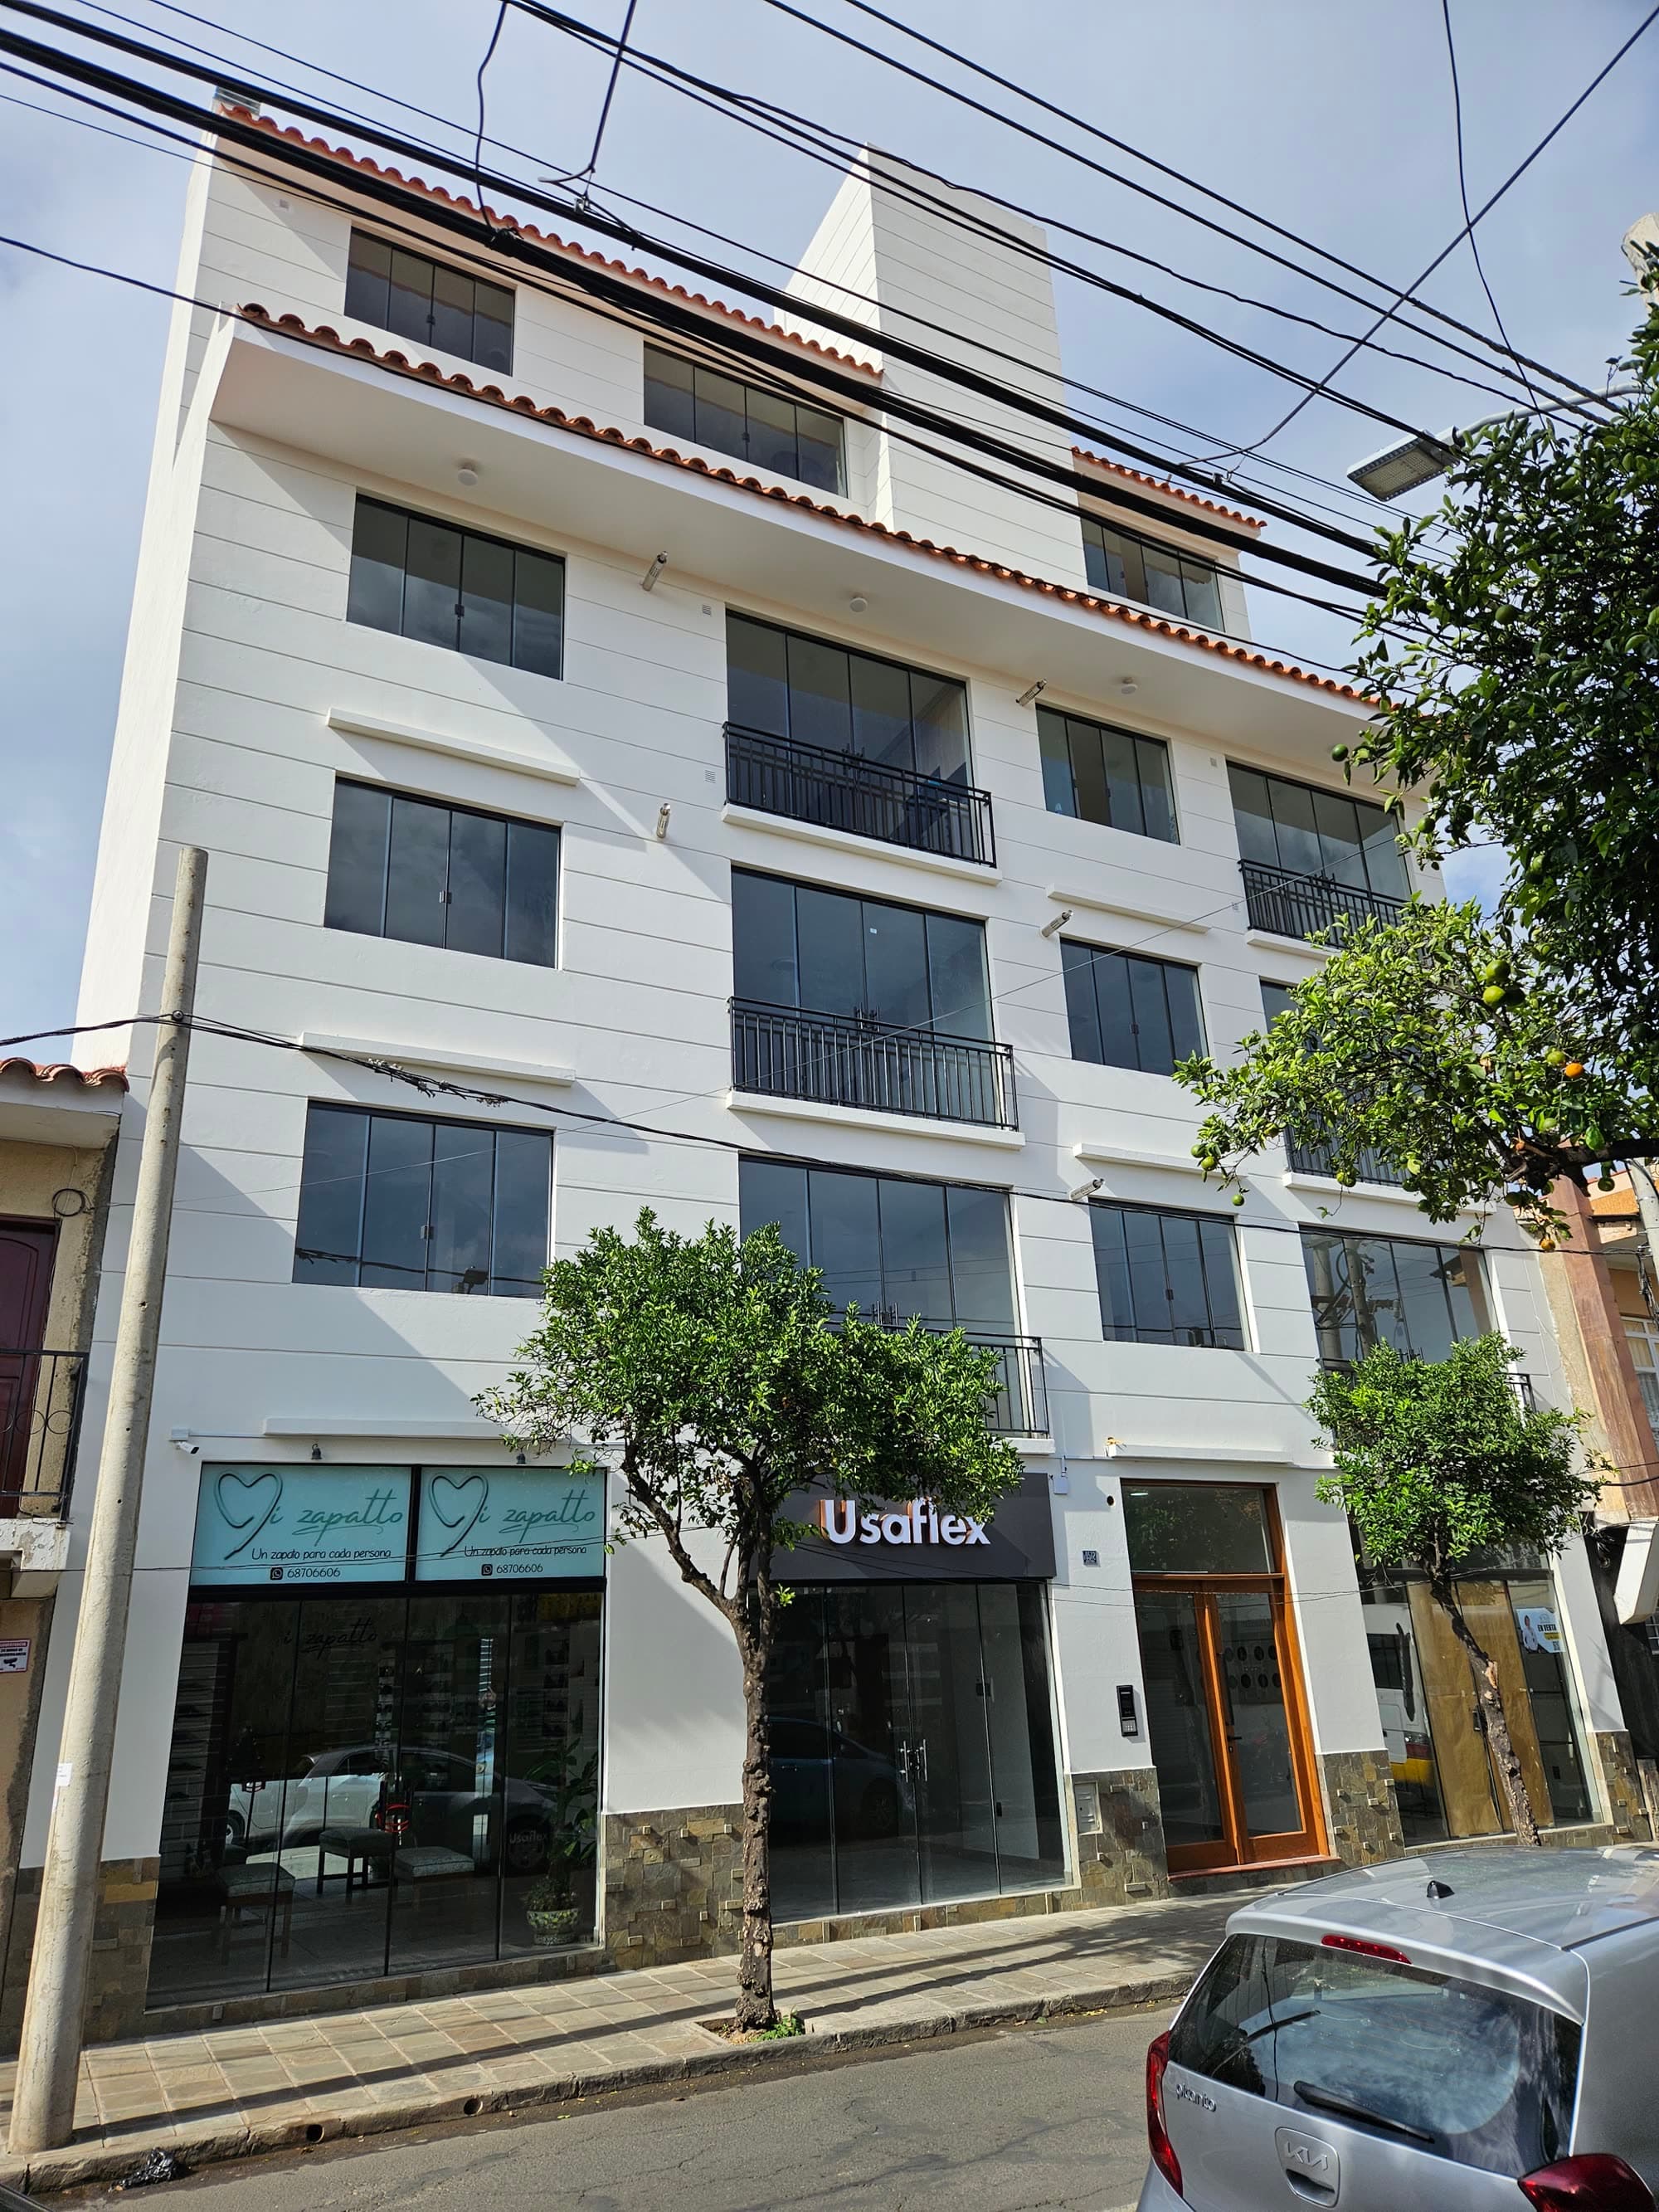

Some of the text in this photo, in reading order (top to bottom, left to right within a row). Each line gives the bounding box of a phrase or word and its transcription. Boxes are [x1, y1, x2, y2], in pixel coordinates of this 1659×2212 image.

[295, 1488, 403, 1547] zapatto
[502, 1489, 596, 1543] zapatto
[820, 1497, 990, 1544] Usaflex
[251, 1547, 392, 1560] Un zapato para cada persona
[464, 1546, 479, 1557] Un
[509, 1546, 531, 1556] para
[553, 1545, 587, 1556] persona
[287, 1567, 341, 1578] 68706606
[496, 1563, 543, 1574] 68706606
[1286, 2140, 1329, 2171] KIA
